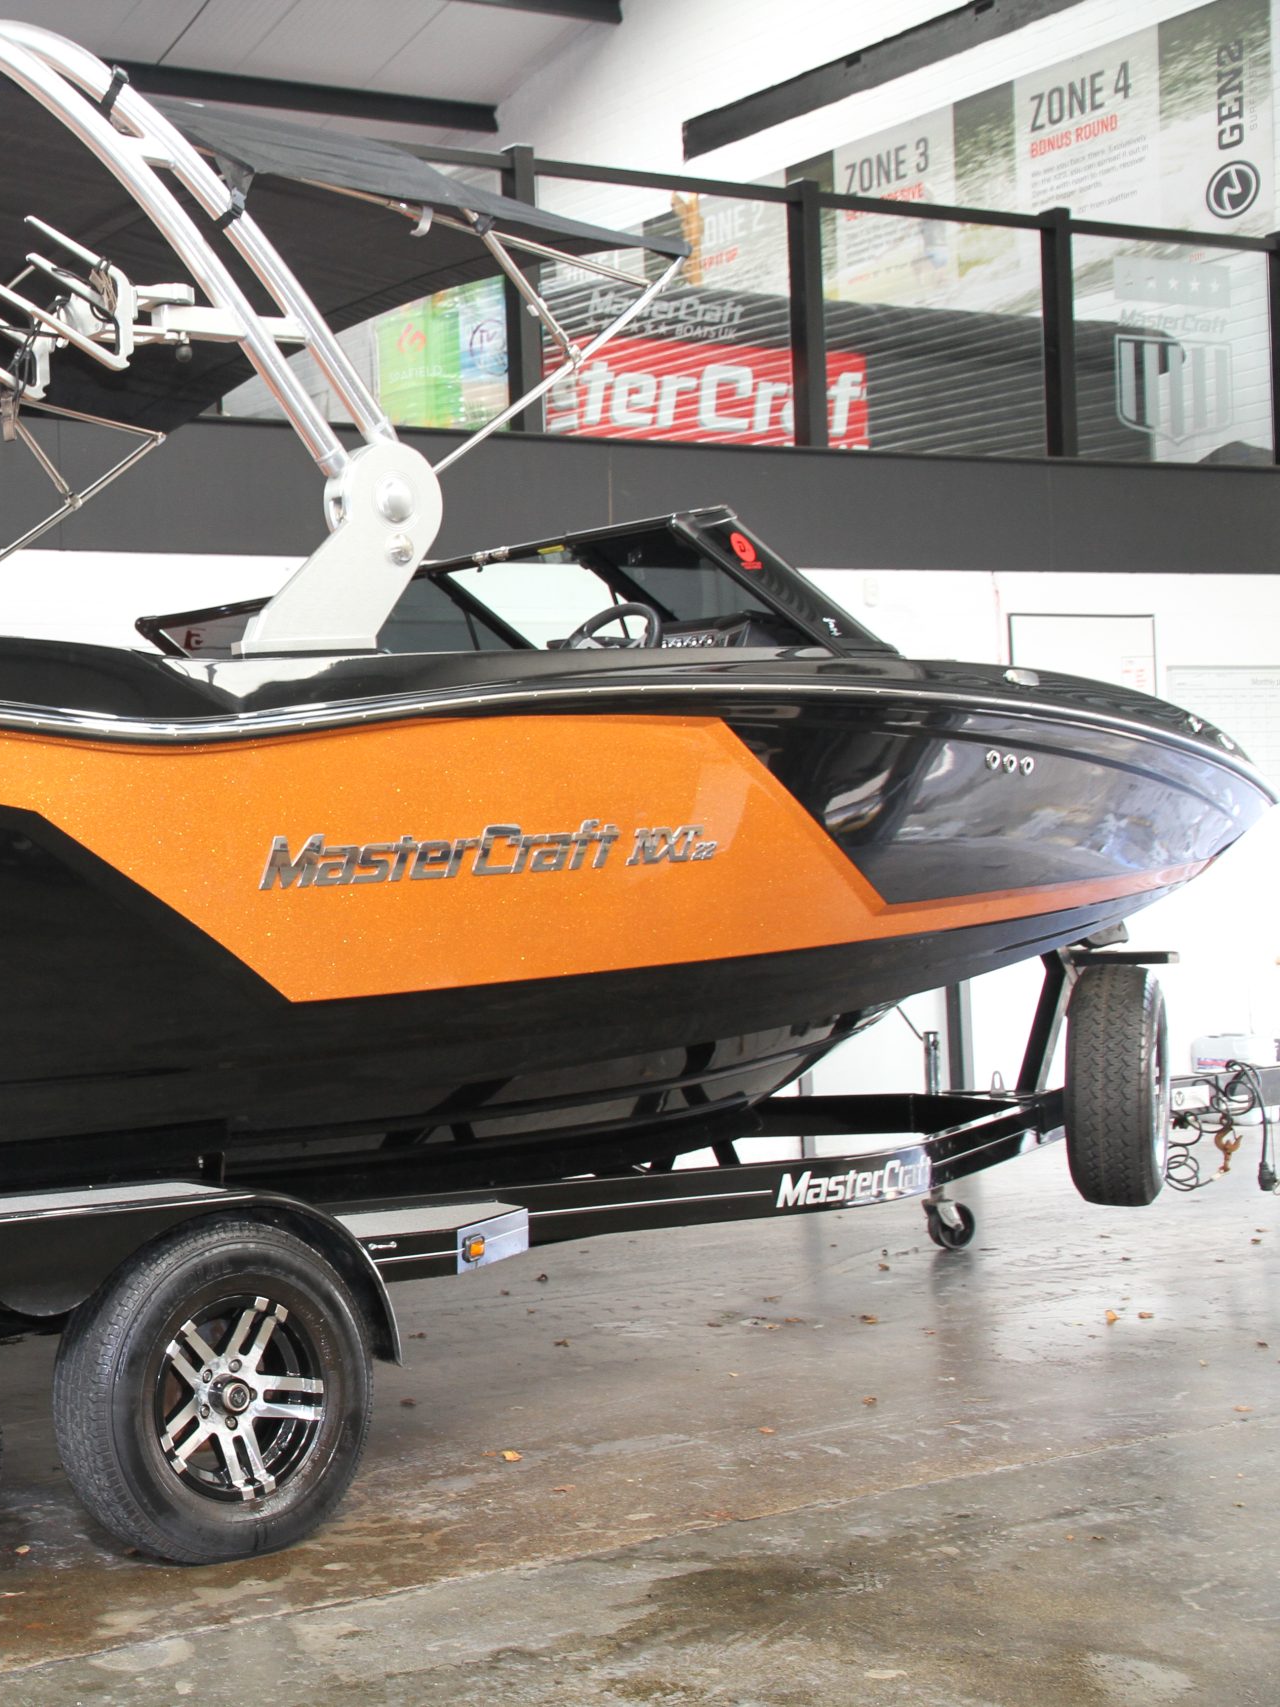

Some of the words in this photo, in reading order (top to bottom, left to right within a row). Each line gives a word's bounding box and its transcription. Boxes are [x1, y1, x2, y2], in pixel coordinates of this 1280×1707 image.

[1030, 70, 1105, 133] ZONE
[1113, 60, 1132, 100] 4
[1216, 38, 1245, 151] GEN2
[1029, 130, 1073, 159] BONUS
[1075, 113, 1118, 142] ROUND
[845, 144, 907, 197] ZONE
[915, 136, 929, 173] 3
[703, 205, 749, 249] ONE
[751, 202, 766, 231] 2
[588, 289, 745, 324] MaterCraft
[1119, 308, 1228, 334] MasterCraft
[258, 819, 620, 890] MasterCraft
[776, 1156, 932, 1208] MasterCraft
